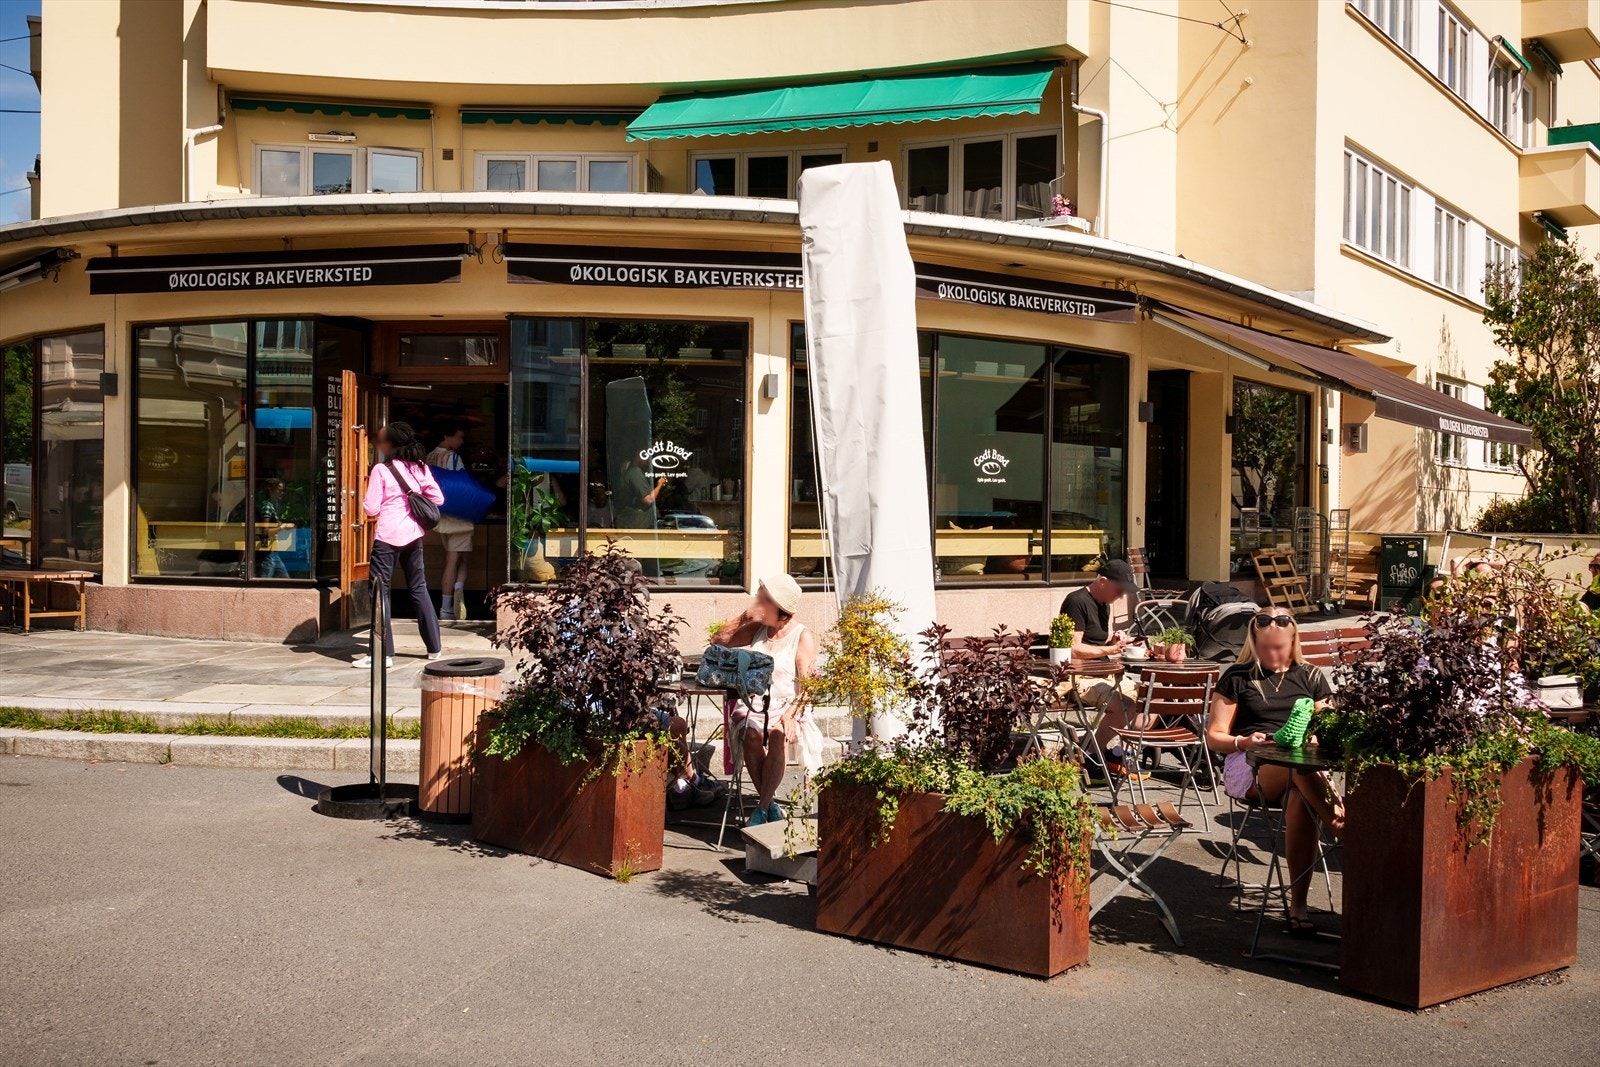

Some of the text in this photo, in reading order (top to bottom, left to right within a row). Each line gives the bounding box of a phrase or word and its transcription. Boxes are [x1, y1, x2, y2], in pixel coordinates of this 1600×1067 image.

[169, 267, 373, 289] ØKOLOGISK BAKEVERKSTED
[570, 264, 804, 288] ØKOLOGISK BAKEVERKSTED
[938, 282, 1096, 317] ØKOLOGISK BAKEVERKSTED
[639, 440, 693, 461] Godt Brød
[973, 448, 1010, 468] Godt Brød
